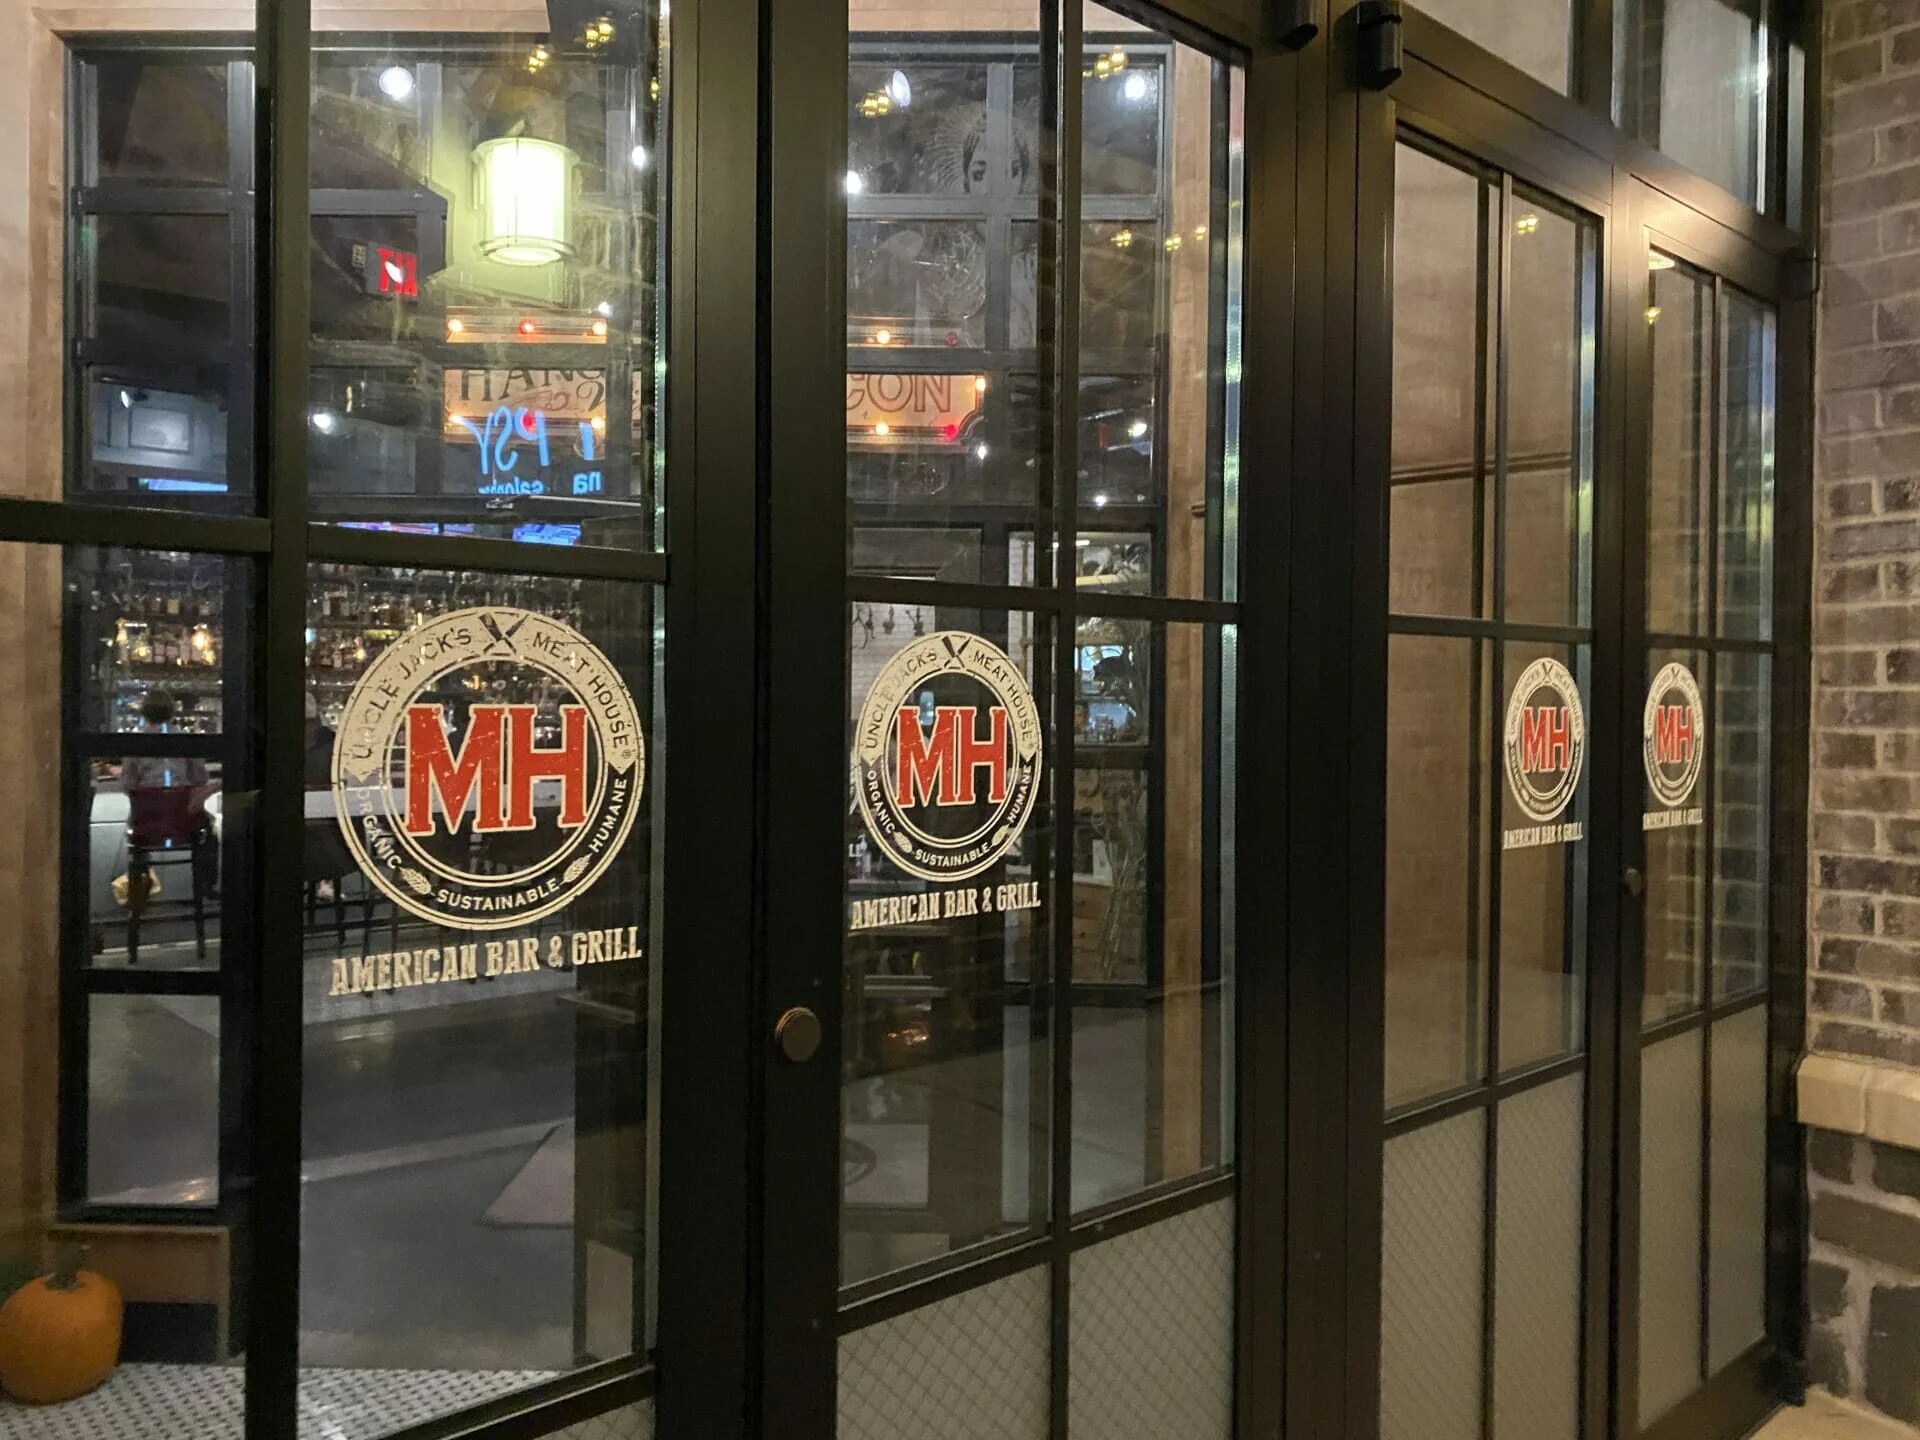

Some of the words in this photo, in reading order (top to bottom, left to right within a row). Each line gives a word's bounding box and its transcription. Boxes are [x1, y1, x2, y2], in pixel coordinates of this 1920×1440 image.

[351, 679, 399, 760] UNCLE
[587, 675, 630, 749] HOUSE
[866, 690, 894, 749] UNCLE
[973, 650, 1008, 682] MEAT
[1007, 684, 1032, 741] HOUSE
[1522, 706, 1569, 773] MH
[1656, 705, 1693, 764] MH
[404, 703, 590, 837] MH
[896, 706, 1007, 809] MH
[357, 789, 402, 869] ORGANIC
[436, 877, 560, 910] SUSTAINABLE
[588, 778, 628, 853] HUMANE
[866, 770, 896, 836] ORGANIC
[914, 842, 990, 866] SUSTAINABLE
[1007, 764, 1031, 824] HUMANE
[850, 892, 940, 930] AMERICAN
[944, 887, 978, 918] BAR
[983, 889, 992, 913] &
[996, 881, 1041, 911] GRILL
[329, 943, 479, 996] AMERICAN
[486, 935, 540, 975] BAR
[548, 935, 564, 969] &
[572, 926, 641, 964] GRILL
